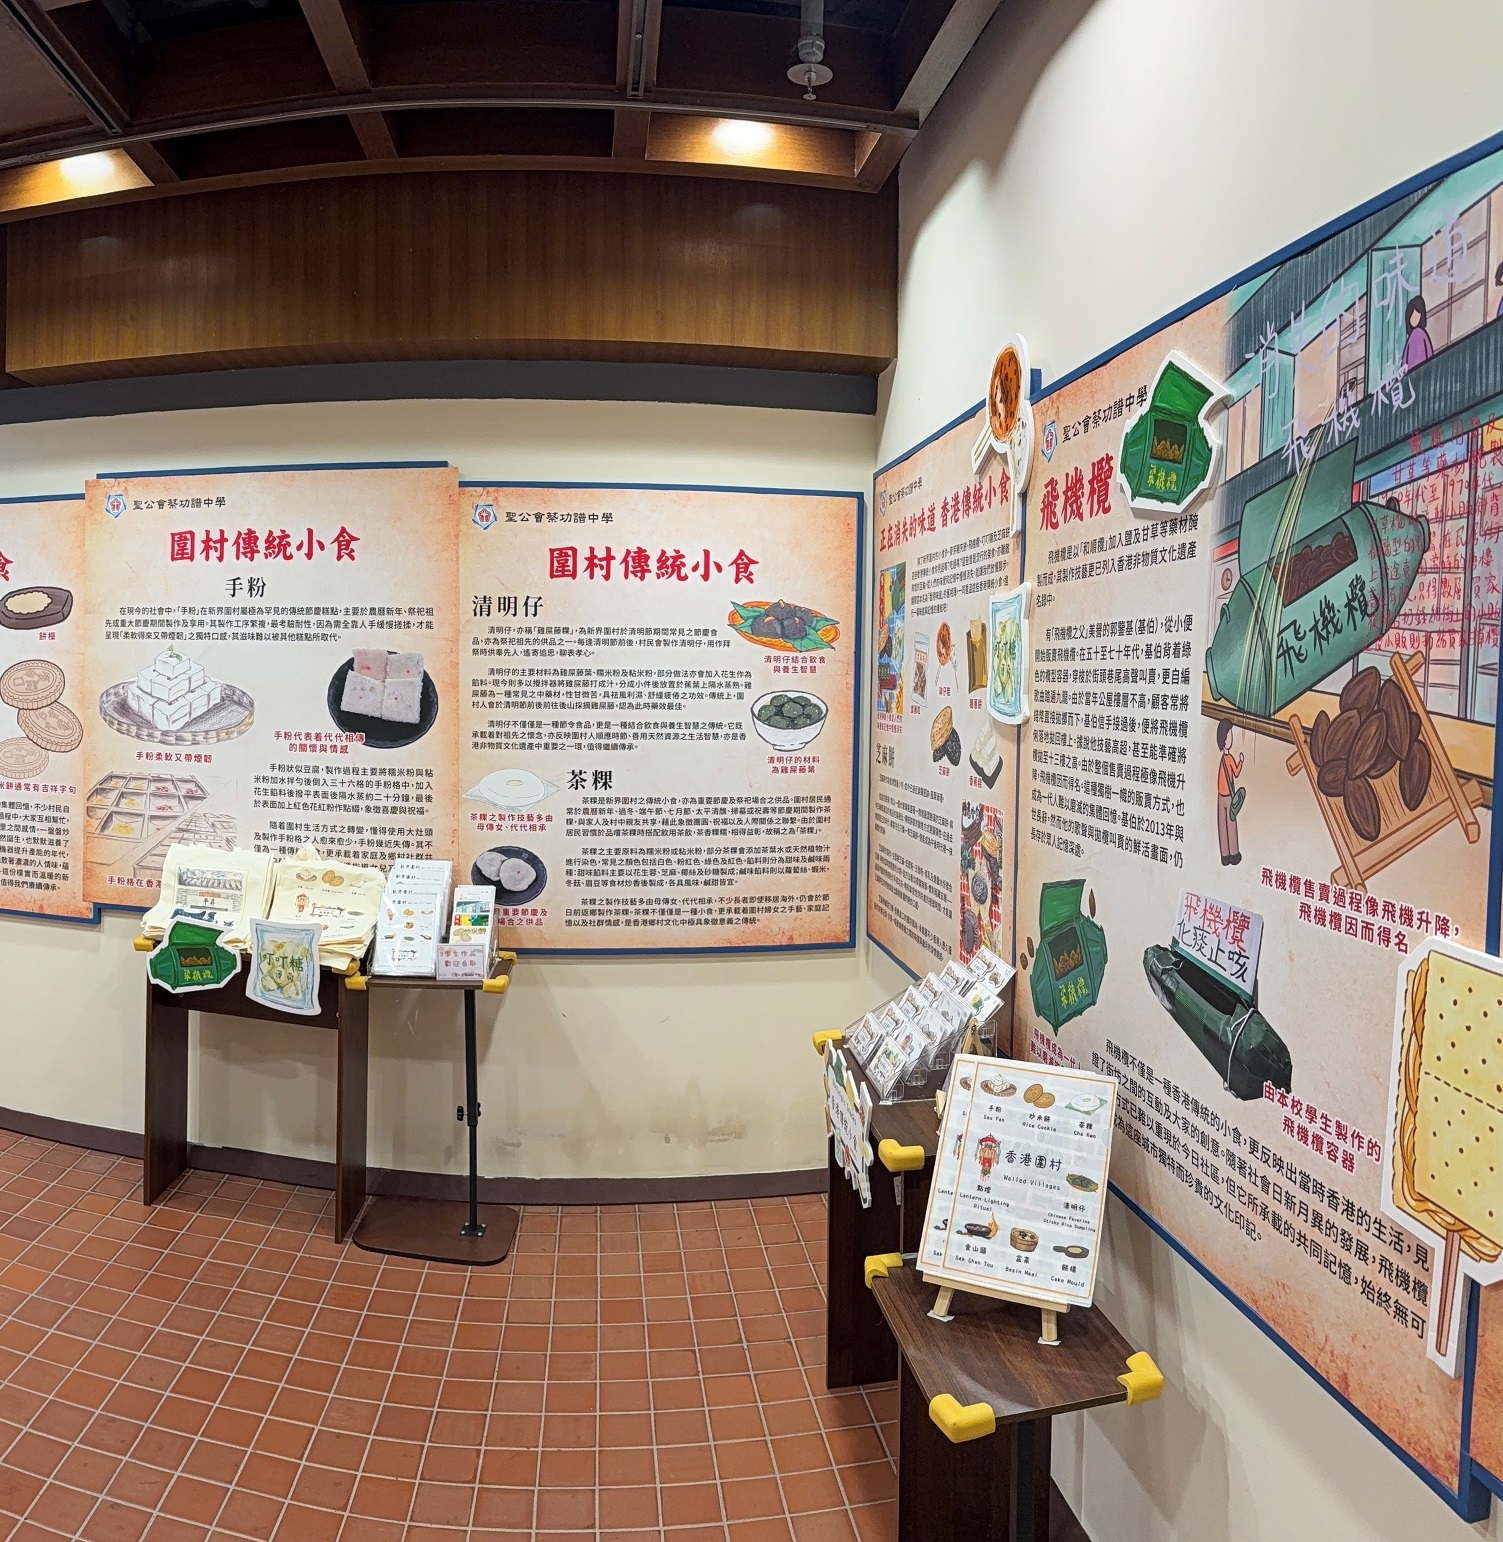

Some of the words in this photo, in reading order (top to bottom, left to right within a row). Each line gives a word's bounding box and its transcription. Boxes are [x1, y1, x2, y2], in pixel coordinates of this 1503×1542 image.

[1062, 385, 1148, 444] 聖公會蔡功譜中學
[940, 467, 1011, 530] 香港傳統小食
[1039, 452, 1115, 532] 飛機欖
[133, 496, 226, 510] 聖公會蔡功譜中學
[505, 511, 614, 524] 聖公會蔡功譜中學
[169, 526, 361, 563] 圍村傳統小食
[548, 545, 760, 584] 圍村傳統小食
[224, 576, 267, 598] 手粉
[472, 595, 544, 617] 清明仔
[1276, 571, 1379, 681] 飛機欖
[566, 770, 614, 791] 茶粿
[1183, 891, 1251, 954] 飛機欖
[1298, 901, 1410, 955] 飛機欖因而得名
[1176, 917, 1251, 984] 化痰止咳
[261, 952, 304, 972] 叮叮糖
[1022, 1121, 1036, 1129] Rice
[1037, 1124, 1057, 1132] Cookie
[1029, 1113, 1051, 1123] 炒米餅
[1263, 1081, 1383, 1165] 由本校學生製作的
[1282, 1116, 1356, 1175] 飛機欖容器
[1005, 1150, 1063, 1172] 香港圍村
[1003, 1174, 1026, 1184] Walled
[1029, 1176, 1062, 1191] Villages
[959, 1192, 982, 1201] Lantern
[984, 1197, 1010, 1208] Lighting
[973, 1203, 993, 1212] Ritual
[1063, 1202, 1086, 1213] 清明仔
[1047, 1212, 1067, 1220] Chinese
[964, 1243, 987, 1255] 食山頭
[1005, 1266, 1023, 1276] Basin
[1024, 1269, 1038, 1278] Meal
[1050, 1275, 1065, 1284] Cake
[1068, 1279, 1085, 1288] Mould
